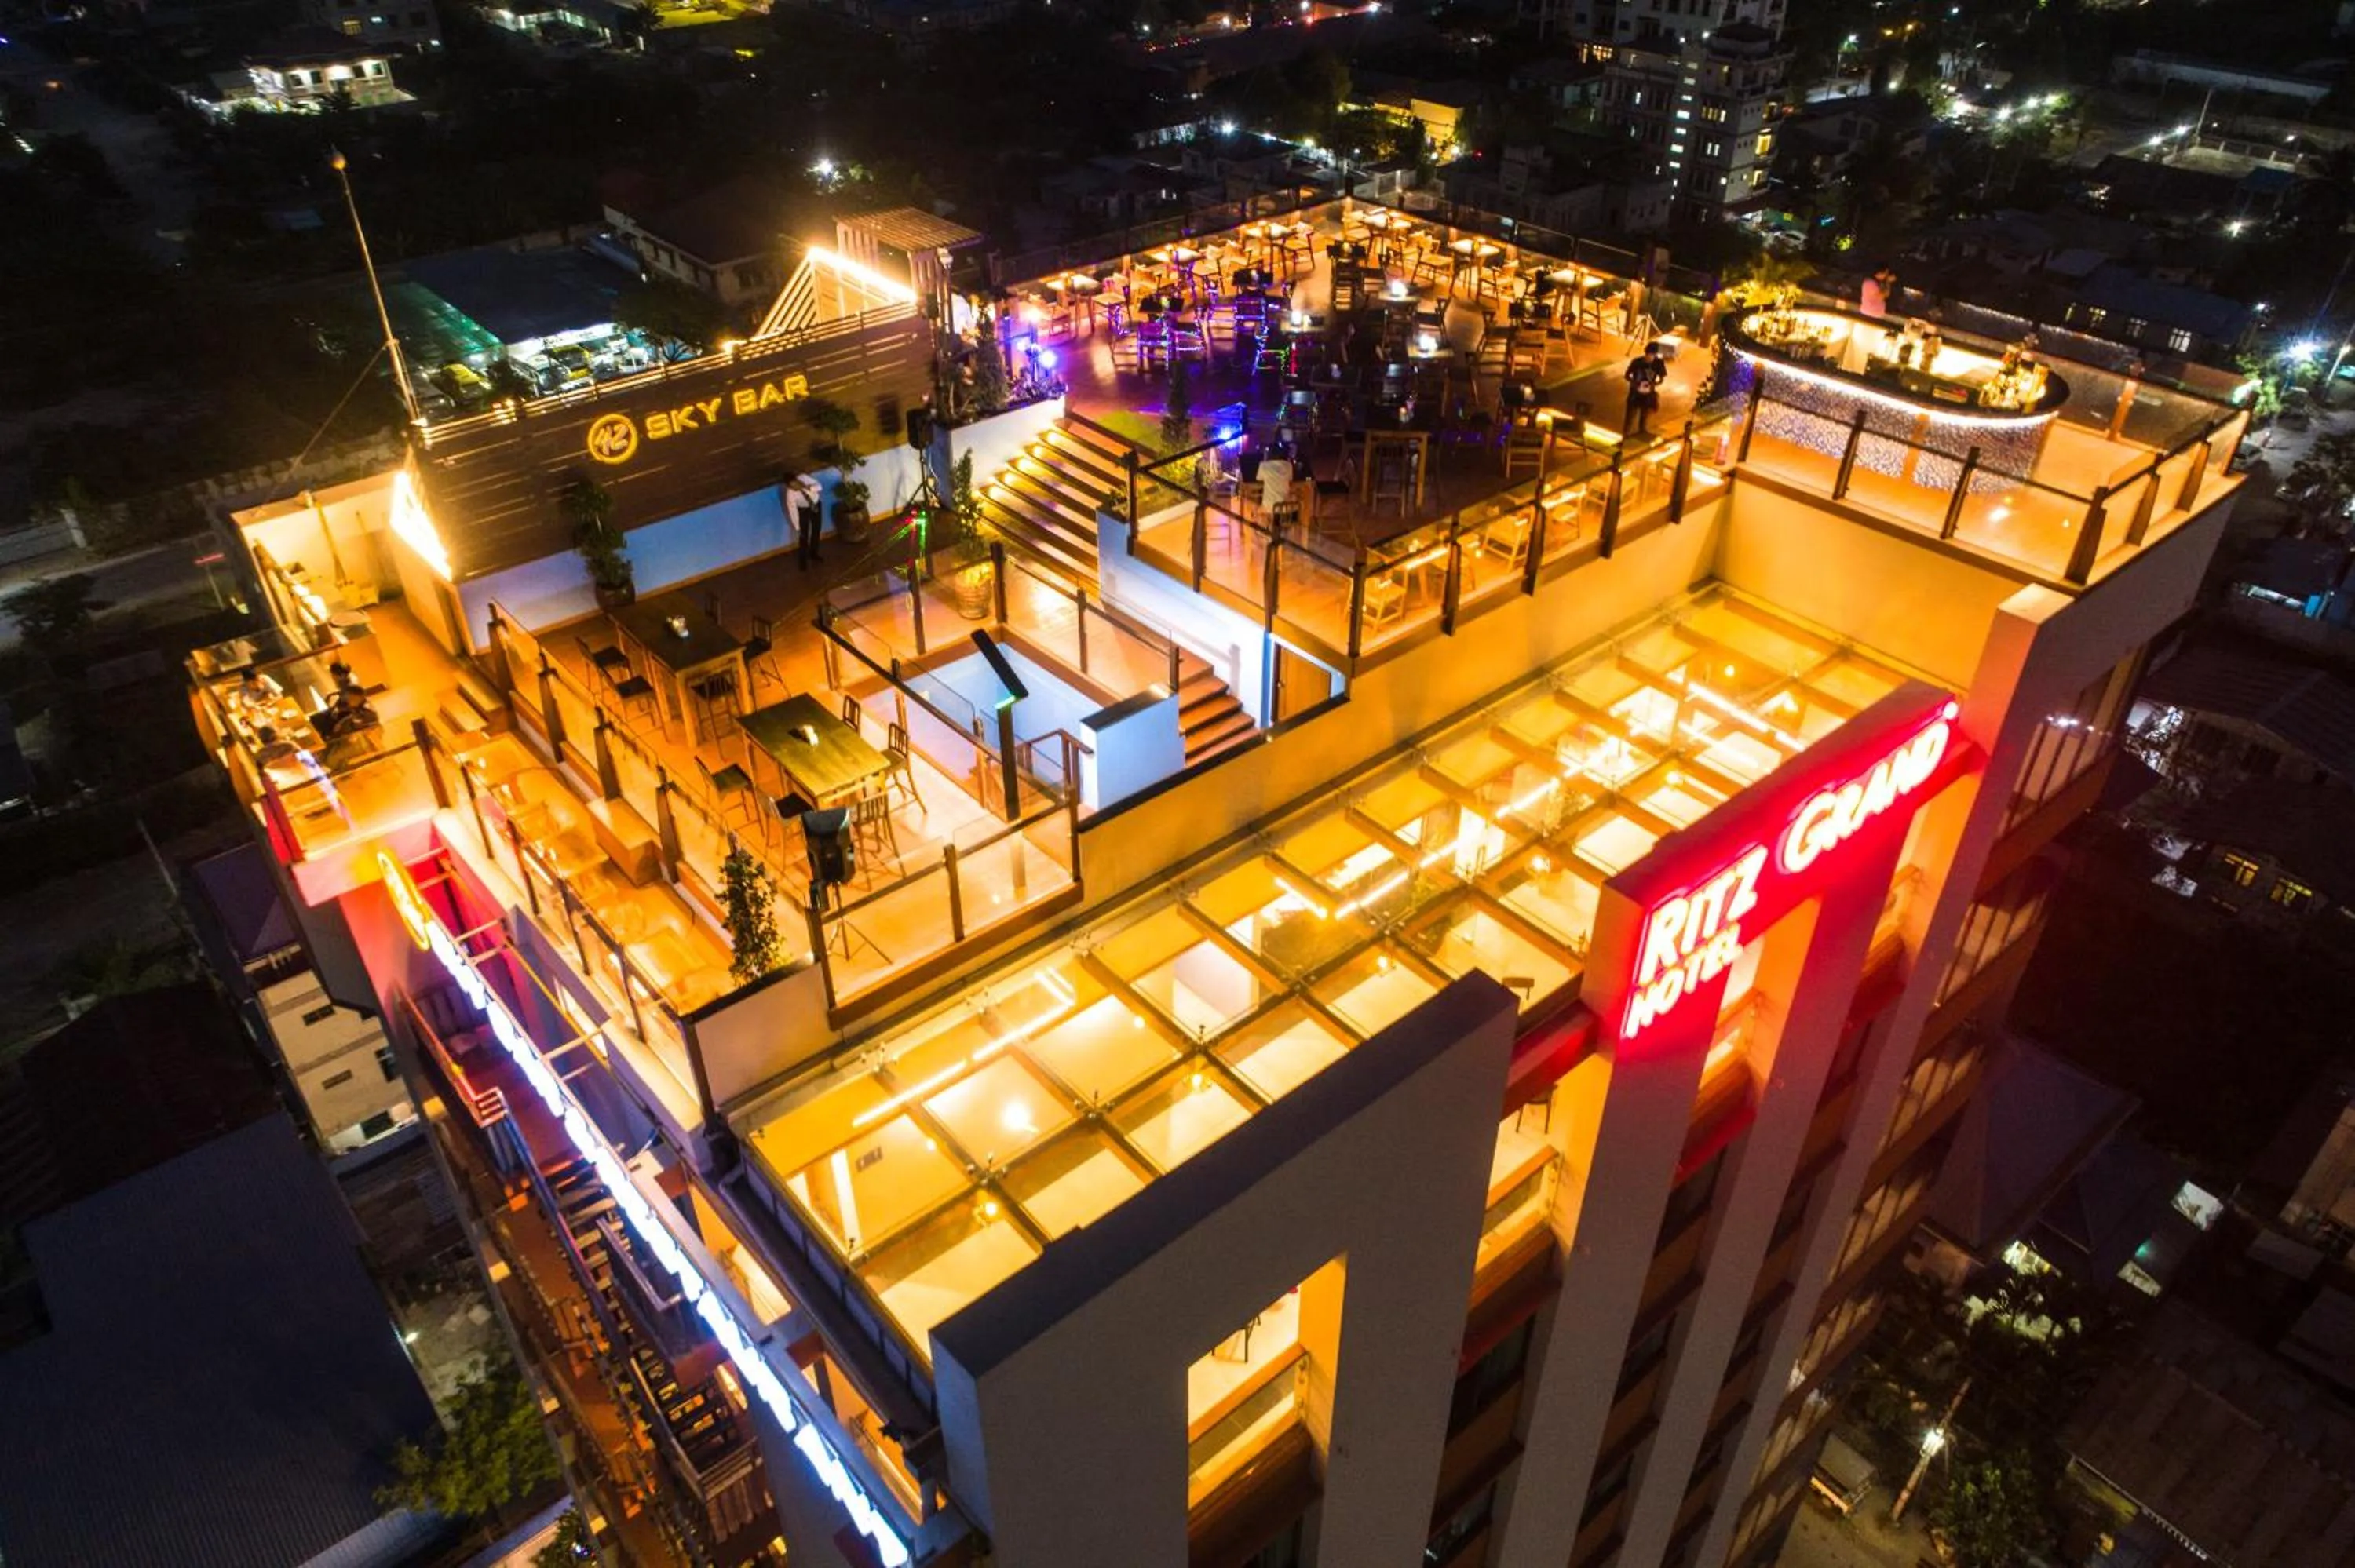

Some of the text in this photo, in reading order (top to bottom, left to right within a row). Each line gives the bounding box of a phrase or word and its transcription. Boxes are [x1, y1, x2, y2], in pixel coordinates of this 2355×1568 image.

[594, 374, 810, 457] 42 SKY BAR
[1639, 721, 1950, 984] RITZ GRAND
[1624, 924, 1743, 1038] HOTEL
